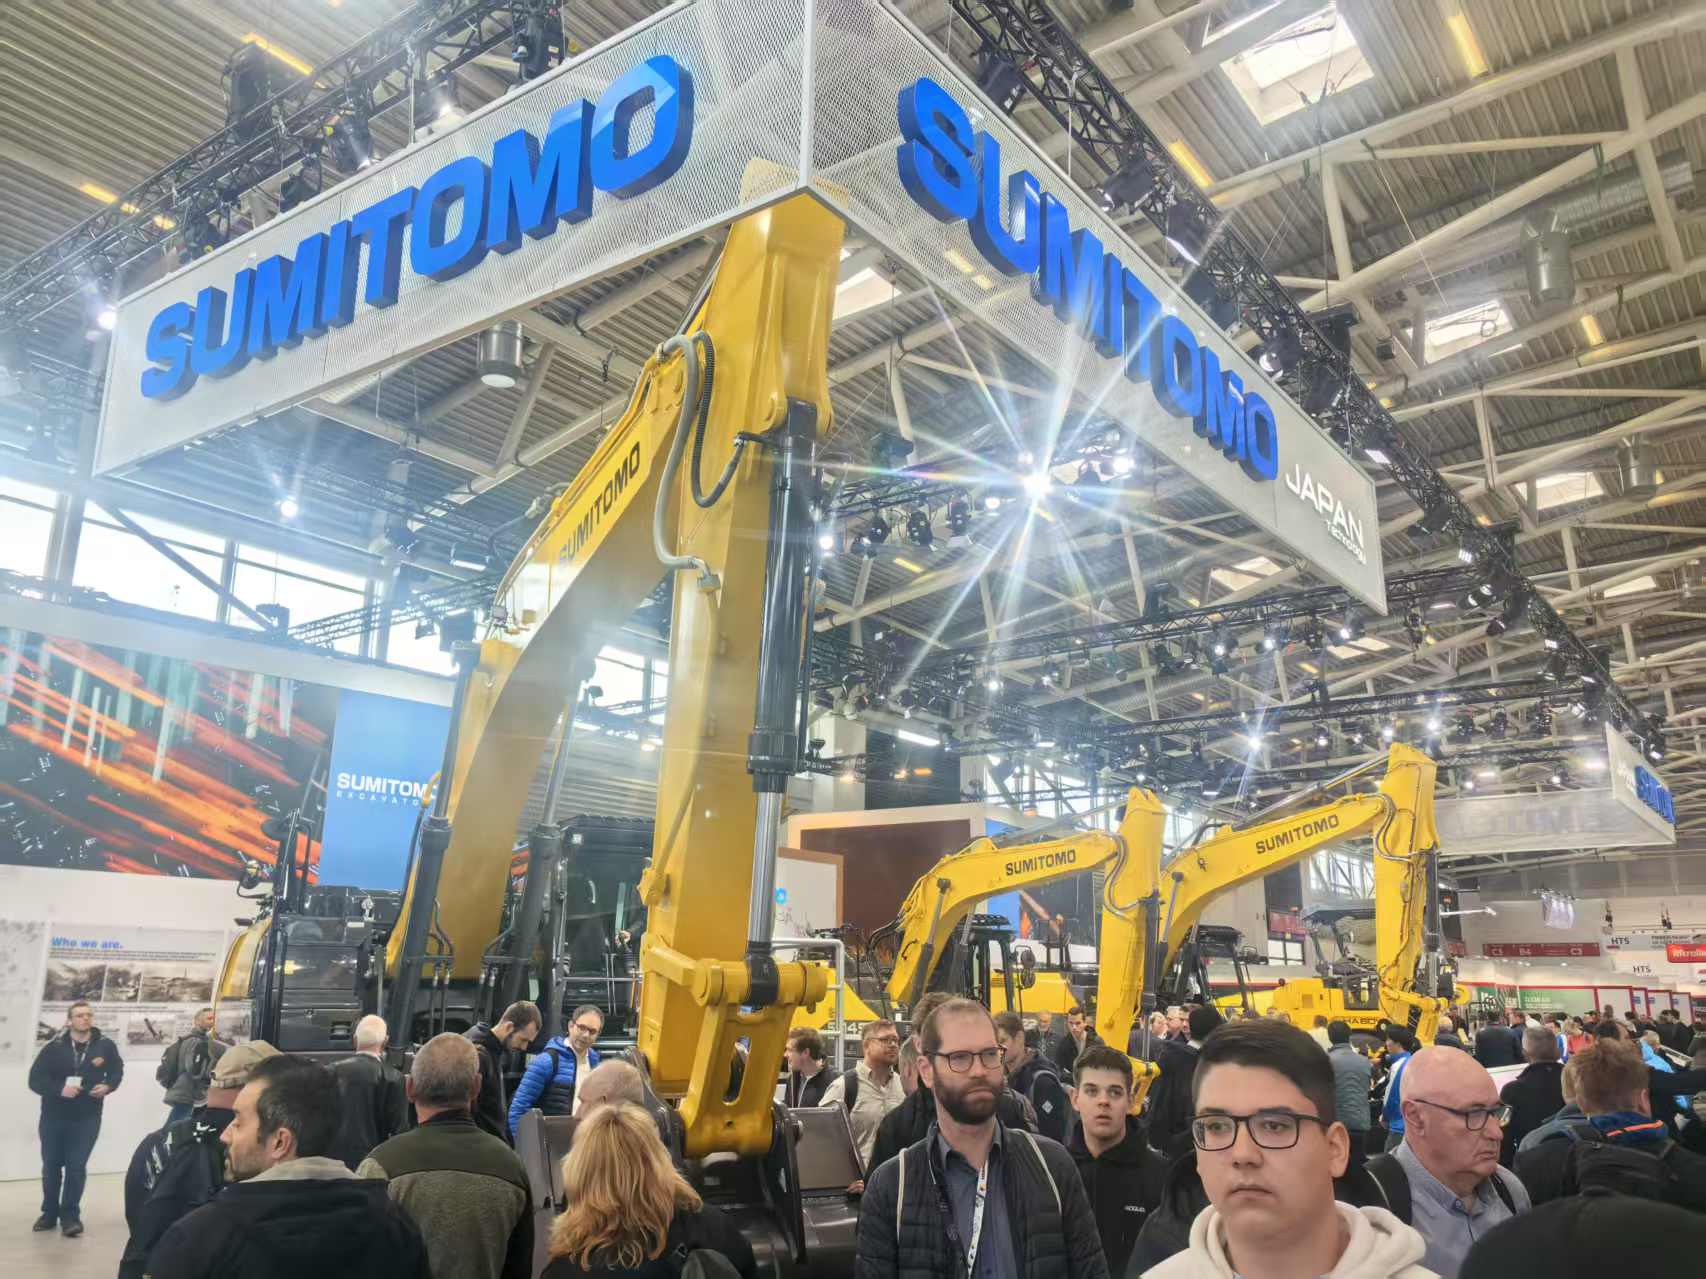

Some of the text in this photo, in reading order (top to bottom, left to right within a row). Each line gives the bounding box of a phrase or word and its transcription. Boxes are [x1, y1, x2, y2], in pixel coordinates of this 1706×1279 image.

[141, 54, 694, 401] SUMITOMO
[897, 76, 1279, 481] SUMITOMO
[1286, 464, 1364, 549] JAPAN
[1256, 814, 1339, 854] SUMITOMO
[1005, 849, 1077, 876] SUMITOMO
[52, 936, 124, 950] Who we are.
[1611, 936, 1630, 945] HTS
